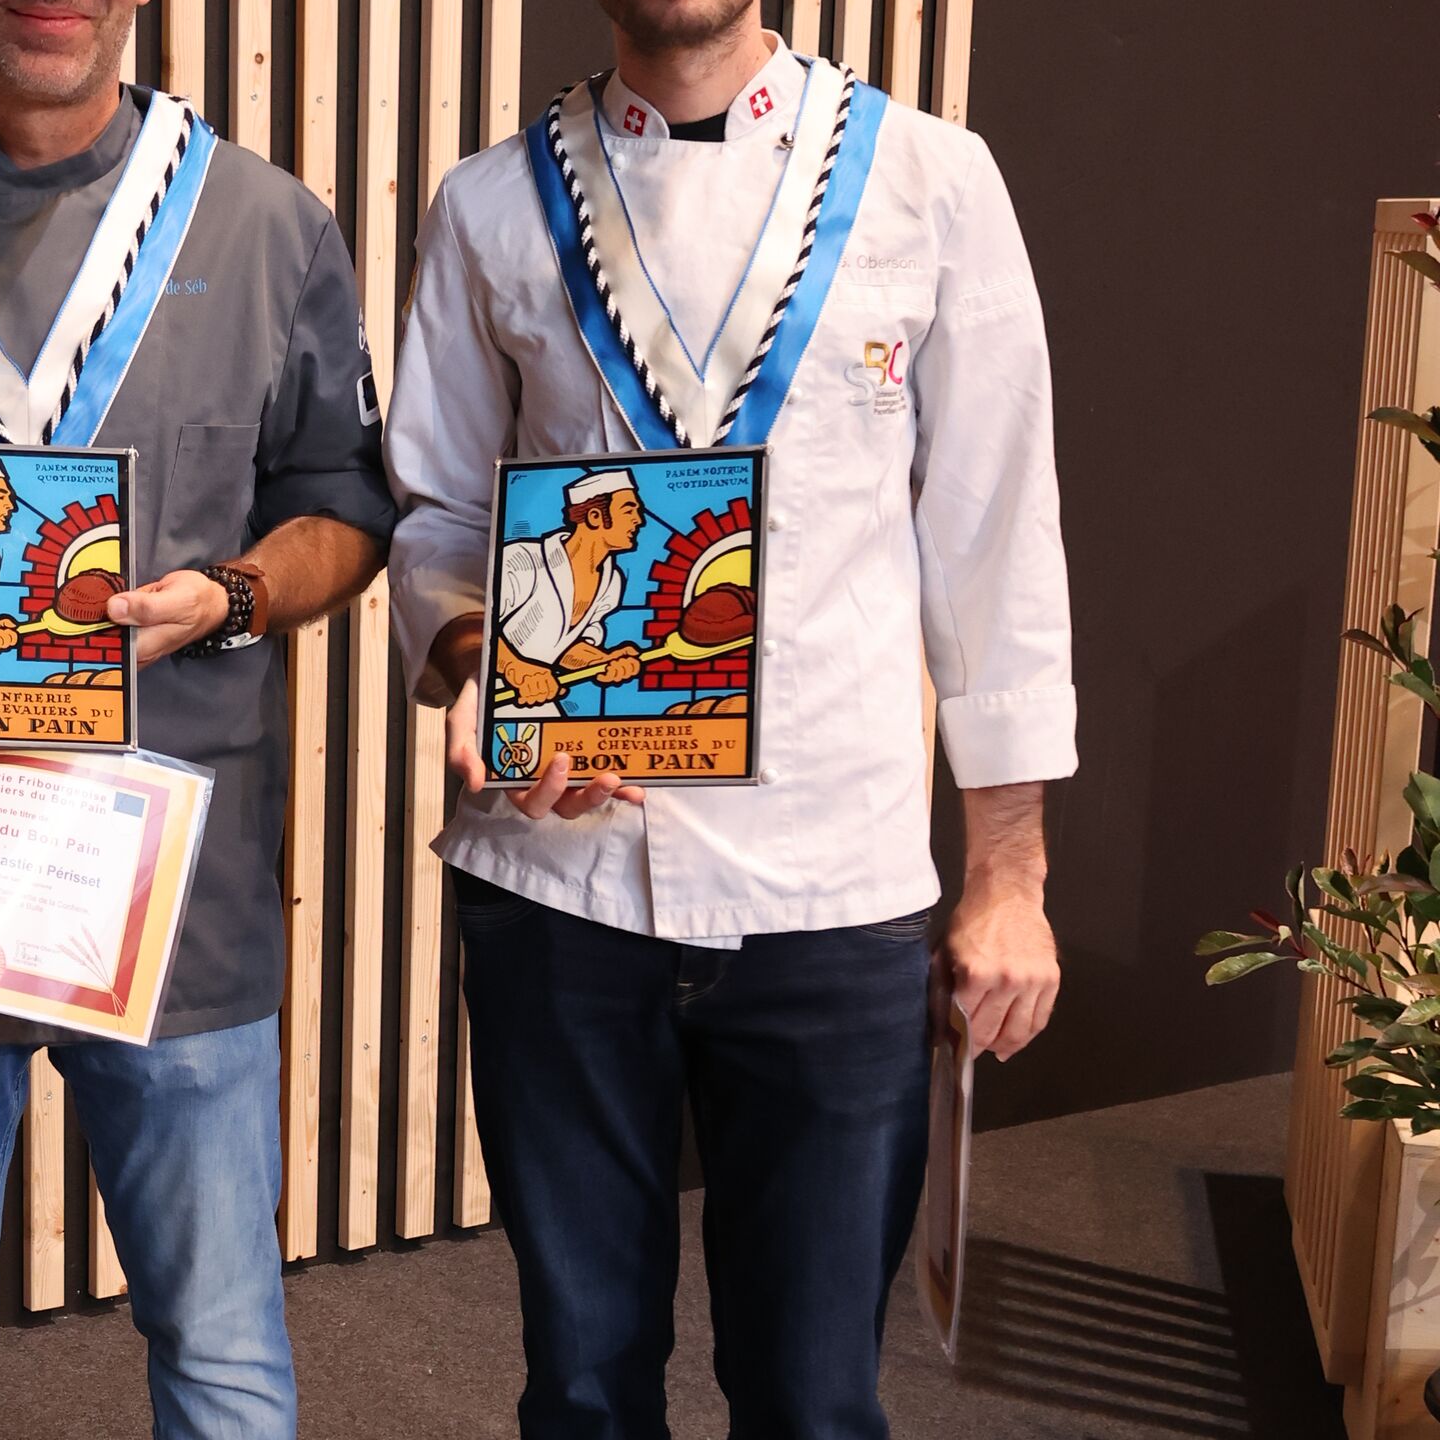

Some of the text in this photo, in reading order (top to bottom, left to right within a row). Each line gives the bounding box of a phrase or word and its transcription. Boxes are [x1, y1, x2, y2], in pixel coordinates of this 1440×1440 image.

[857, 255, 917, 270] Oberson
[35, 464, 114, 474] PANEM NOSTRUM
[666, 466, 748, 478] PANEM NOSTRUM
[37, 475, 115, 483] QUOTIDIANUM
[667, 477, 749, 492] QUOTIDIANUM
[91, 708, 114, 718] DU
[28, 718, 98, 735] PAIN
[598, 725, 693, 738] CONFRERIE
[554, 739, 737, 752] DES CHEVALIERS DU
[571, 753, 719, 771] BON PAIN
[30, 790, 46, 801] du
[80, 802, 107, 815] Pain
[20, 809, 37, 820] titre
[0, 824, 20, 838] du
[66, 838, 100, 857] Pain
[47, 864, 102, 888] Périsset
